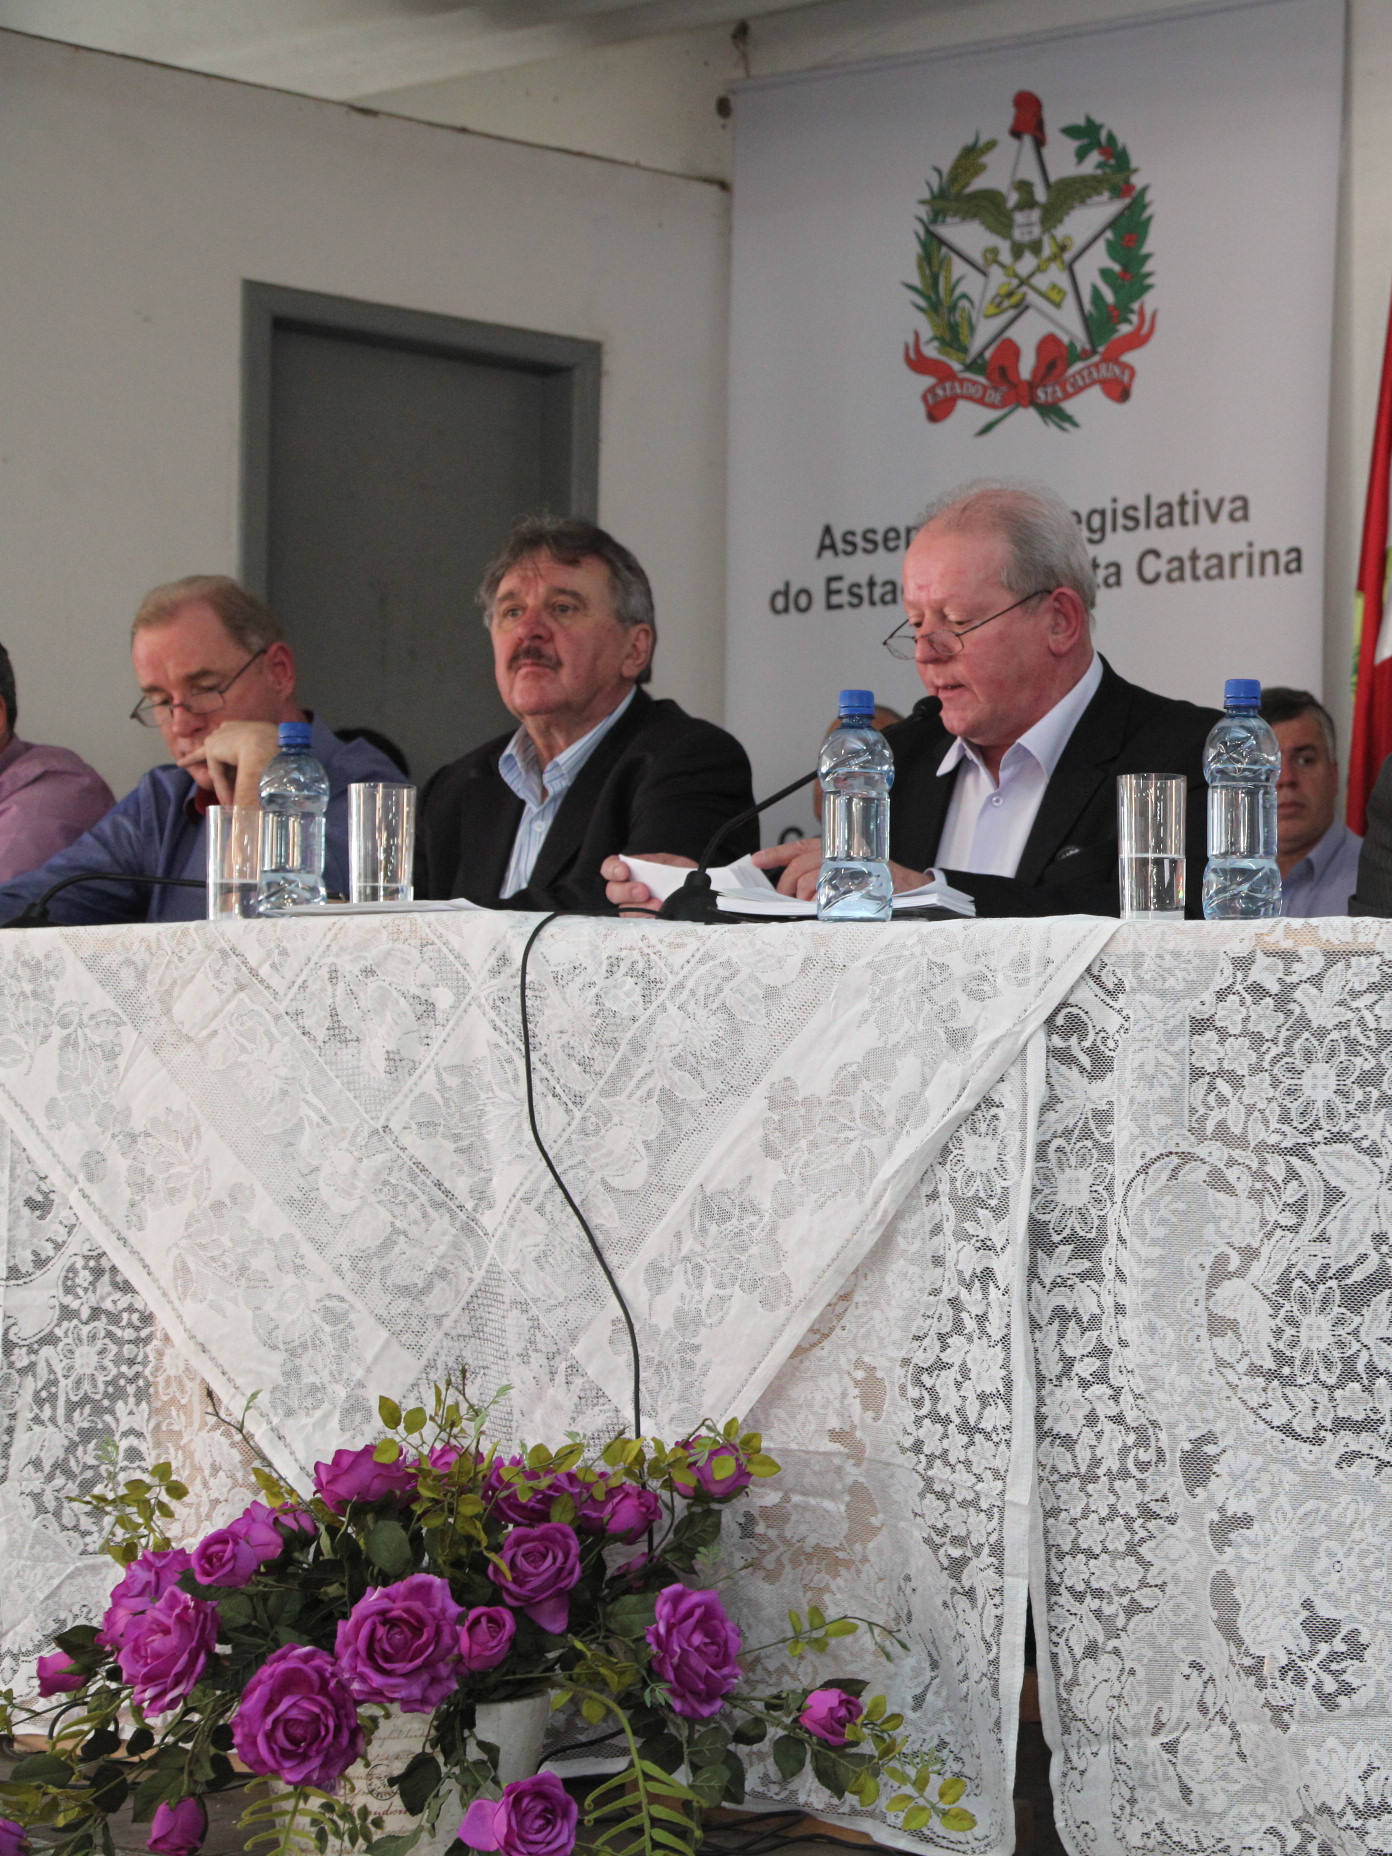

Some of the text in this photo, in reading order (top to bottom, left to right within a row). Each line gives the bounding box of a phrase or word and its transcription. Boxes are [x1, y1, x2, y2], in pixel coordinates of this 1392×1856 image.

[926, 381, 983, 406] ESTADO
[1065, 362, 1131, 393] CATARINA
[769, 578, 813, 615] do
[1137, 541, 1303, 585] Catarina
